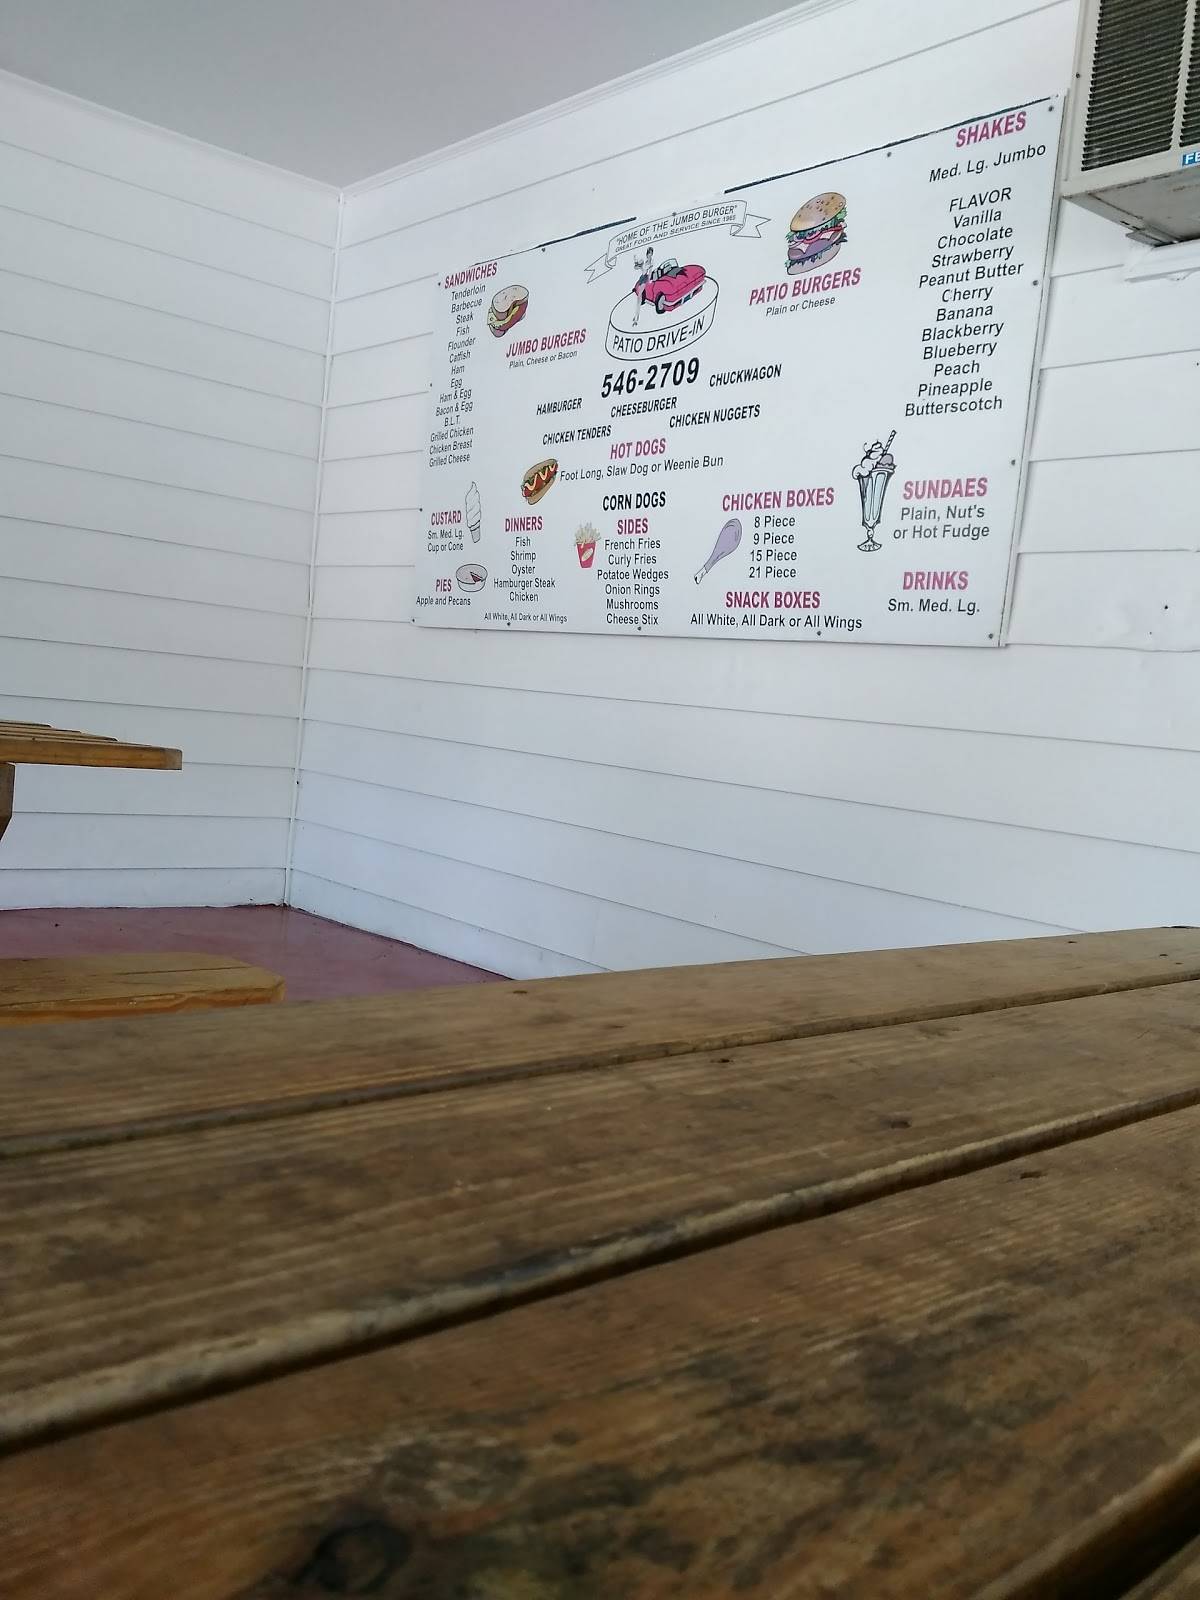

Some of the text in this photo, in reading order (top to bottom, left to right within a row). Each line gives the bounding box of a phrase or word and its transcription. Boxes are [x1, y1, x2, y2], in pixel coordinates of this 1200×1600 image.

[956, 111, 1026, 148] SHAKES
[929, 144, 1046, 183] Med. Lg. Jumbo
[949, 187, 1012, 212] FLAVOR
[640, 226, 651, 237] OF
[653, 220, 668, 232] THE
[671, 211, 700, 227] JUMBO
[953, 209, 1002, 228] Vanilla
[615, 242, 632, 253] GREAT
[634, 236, 652, 246] FOOD
[653, 231, 668, 240] AND
[670, 223, 699, 234] SERVICE
[701, 218, 724, 227] SINCE
[937, 226, 1013, 250] Chocolate
[931, 244, 1014, 268] Strawberry
[444, 262, 498, 289] SANDWICHES
[919, 262, 1024, 288] Peanut Butter
[451, 284, 486, 301] Tenderloin
[749, 267, 861, 306] PATIO BURGERS
[942, 285, 993, 303] Cherry
[451, 298, 482, 313] Barbecue
[766, 297, 836, 317] Plain or Cheese
[936, 304, 993, 321] Banana
[455, 312, 474, 324] Steak
[456, 325, 470, 337] Fish
[613, 316, 705, 353] PATIO DRIVE-IN
[921, 321, 1004, 342] Blackberry
[447, 337, 476, 351] Flounder
[506, 328, 587, 359] JUMBO BURGERS
[923, 340, 997, 360] Blueberry
[449, 350, 471, 364] Catfish
[509, 350, 578, 370] Plain, Cheese or Bacon
[451, 365, 465, 375] Ham
[709, 363, 782, 387] CHUCKWAGON
[934, 361, 980, 377] Peach
[450, 378, 463, 389] Egg
[601, 357, 700, 398] 546-2709
[440, 388, 472, 403] Ham & Egg
[918, 379, 993, 398] Pineapple
[436, 405, 453, 417] Bacon
[460, 401, 474, 413] Egg
[536, 397, 582, 416] HAMBURGER
[610, 396, 678, 418] CHEESEBURGER
[905, 395, 1003, 417] Butterscotch
[444, 414, 460, 427] B.L.T.
[669, 404, 761, 428] CHICKEN NUGGETS
[431, 427, 474, 442] Grilled Chicken
[542, 424, 612, 446] CHICKEN TENDERS
[429, 439, 473, 455] Chicken Breast
[610, 438, 666, 460] HOT DOGS
[429, 453, 470, 467] Grilled Cheese
[560, 455, 724, 482] Foot Long, Slaw Dog or Weenie Bun
[902, 477, 988, 500] SUNDAES
[602, 491, 666, 512] CORN DOGS
[722, 487, 835, 512] CHICKEN BOXES
[431, 510, 462, 526] CUSTARD
[901, 505, 985, 521] Plain, Nut's
[505, 516, 543, 532] DINNERS
[617, 518, 649, 535] SIDES
[754, 516, 796, 528] 8 Piece
[427, 529, 464, 540] Sm. Med. Lg.
[753, 533, 795, 545] 9 Piece
[893, 524, 990, 540] or Hot Fudge
[427, 541, 464, 553] Cup or Cone
[515, 537, 531, 547] Fish
[604, 538, 661, 551] French Fries
[510, 550, 537, 562] Shrimp
[608, 554, 657, 566] Curly Fries
[750, 550, 797, 562] 15 Piece
[511, 564, 536, 575] Oyster
[597, 569, 669, 582] Potatoe Wedges
[749, 567, 797, 579] 21 Piece
[435, 578, 452, 592] PIES
[493, 578, 556, 590] Hamburger Steak
[902, 571, 968, 591] DRINKS
[509, 592, 539, 602] Chicken
[605, 584, 660, 598] Onion Rings
[416, 596, 471, 607] Apple and Pecans
[606, 599, 659, 610] Mushrooms
[725, 591, 820, 609] SNACK BOXES
[887, 599, 981, 615] Sm. Med. Lg.
[484, 612, 492, 620] All
[492, 613, 509, 622] White,
[510, 613, 518, 621] All
[518, 613, 532, 621] Dark
[540, 614, 548, 622] All
[549, 614, 567, 624] Wings
[606, 613, 659, 625] Cheese Stix
[690, 614, 863, 631] All White, All Dark or All Wings
